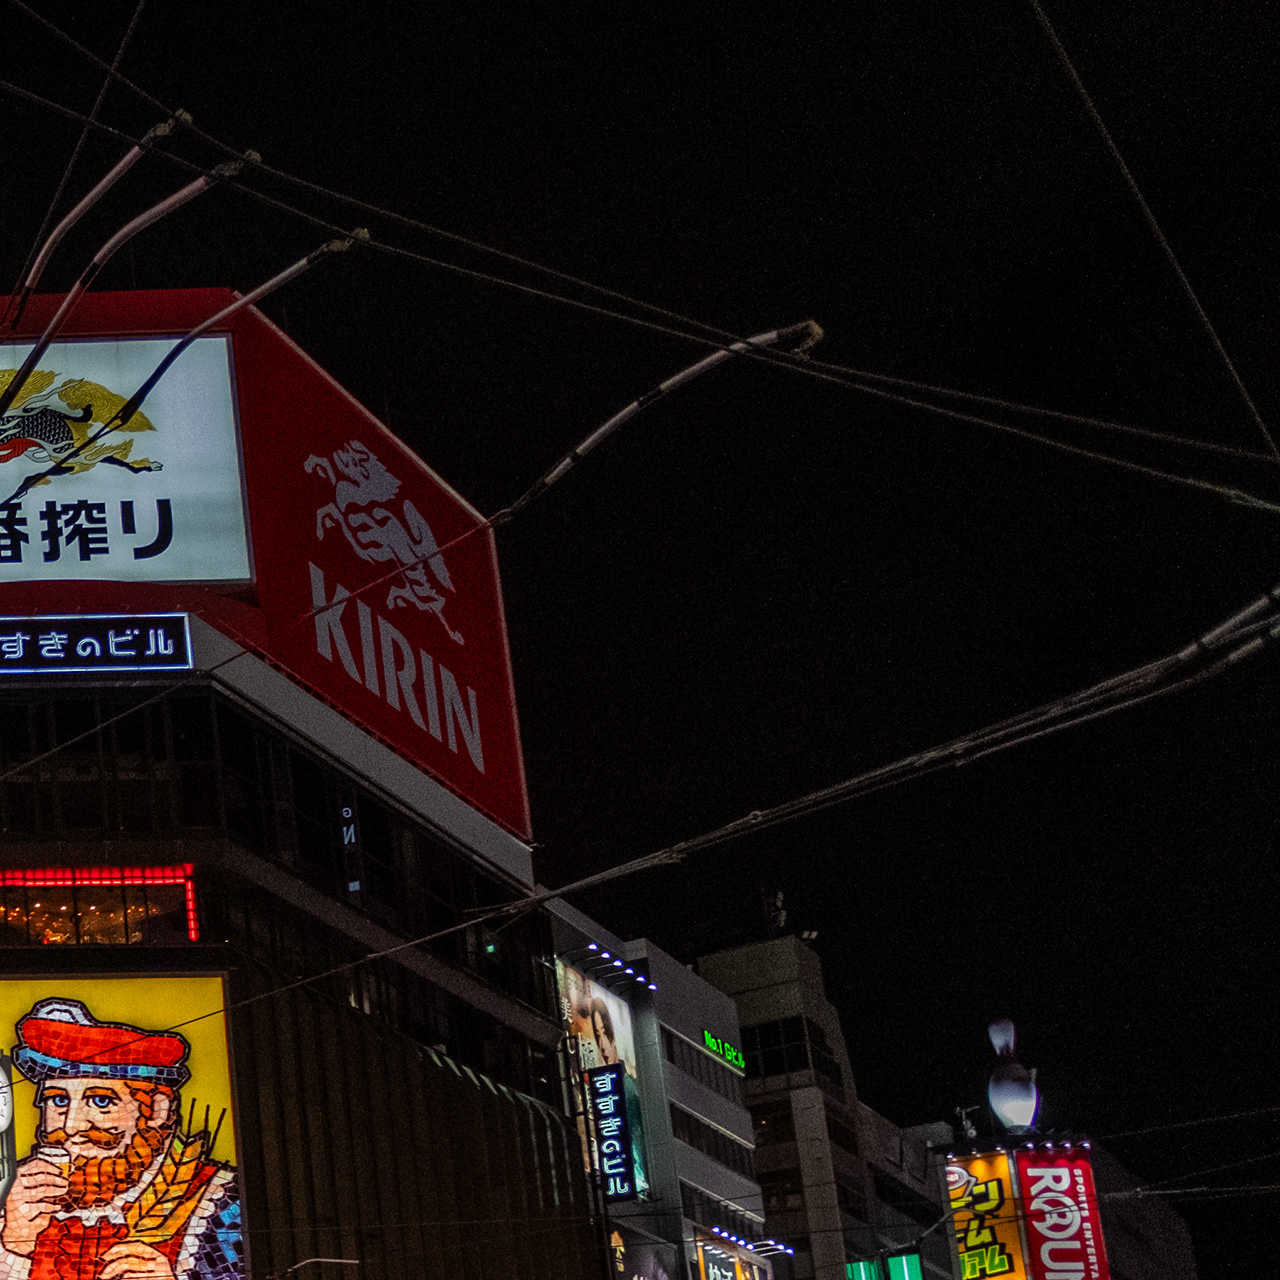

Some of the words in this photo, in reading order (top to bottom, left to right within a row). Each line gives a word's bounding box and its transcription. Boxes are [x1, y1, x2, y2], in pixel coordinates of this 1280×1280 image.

[308, 561, 487, 774] KIRIN
[594, 1072, 629, 1195] すすきのビル
